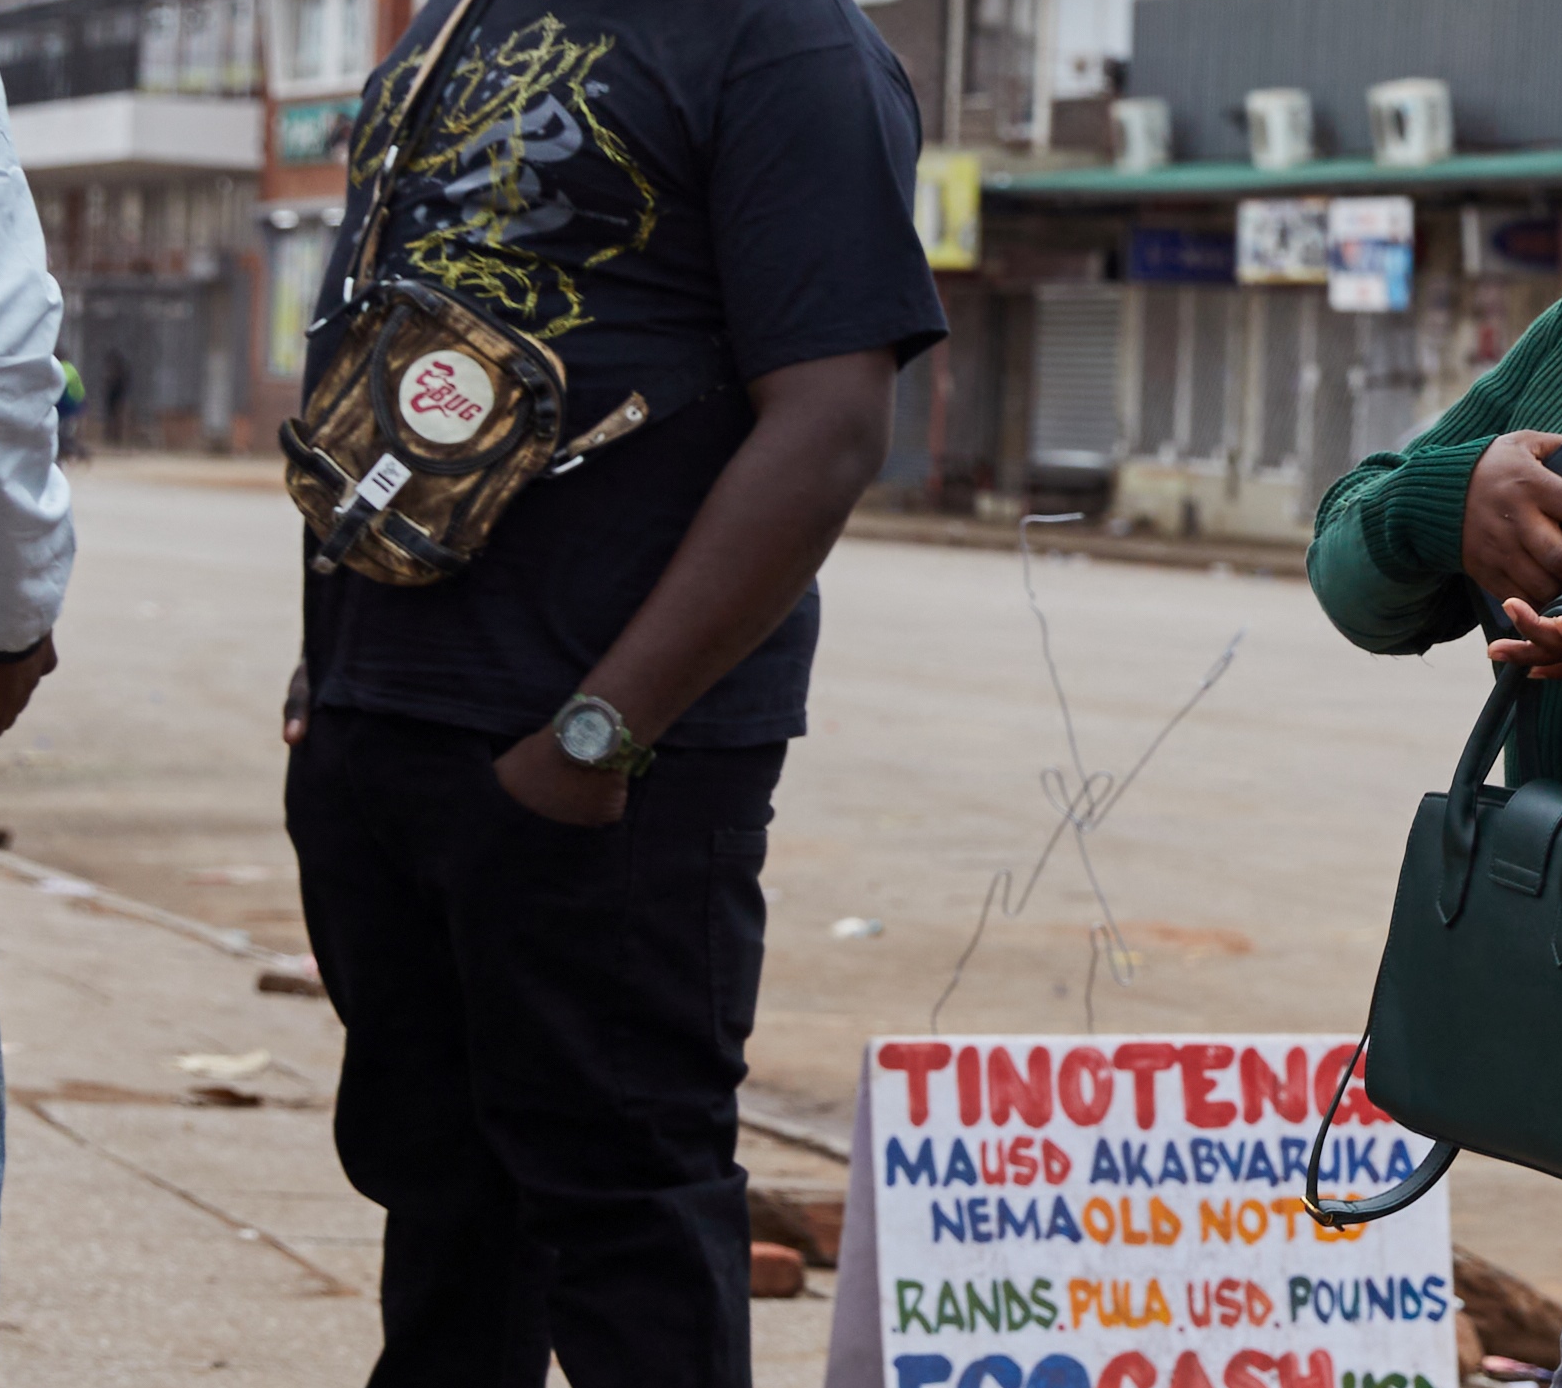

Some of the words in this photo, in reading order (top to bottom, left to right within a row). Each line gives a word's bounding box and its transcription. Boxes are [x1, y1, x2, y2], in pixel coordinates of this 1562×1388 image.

[1089, 1136, 1415, 1188] AKABVARUKA
[1067, 1278, 1172, 1332] PULA
[1186, 1275, 1274, 1330] USD
[1288, 1273, 1449, 1324] POUNDS
